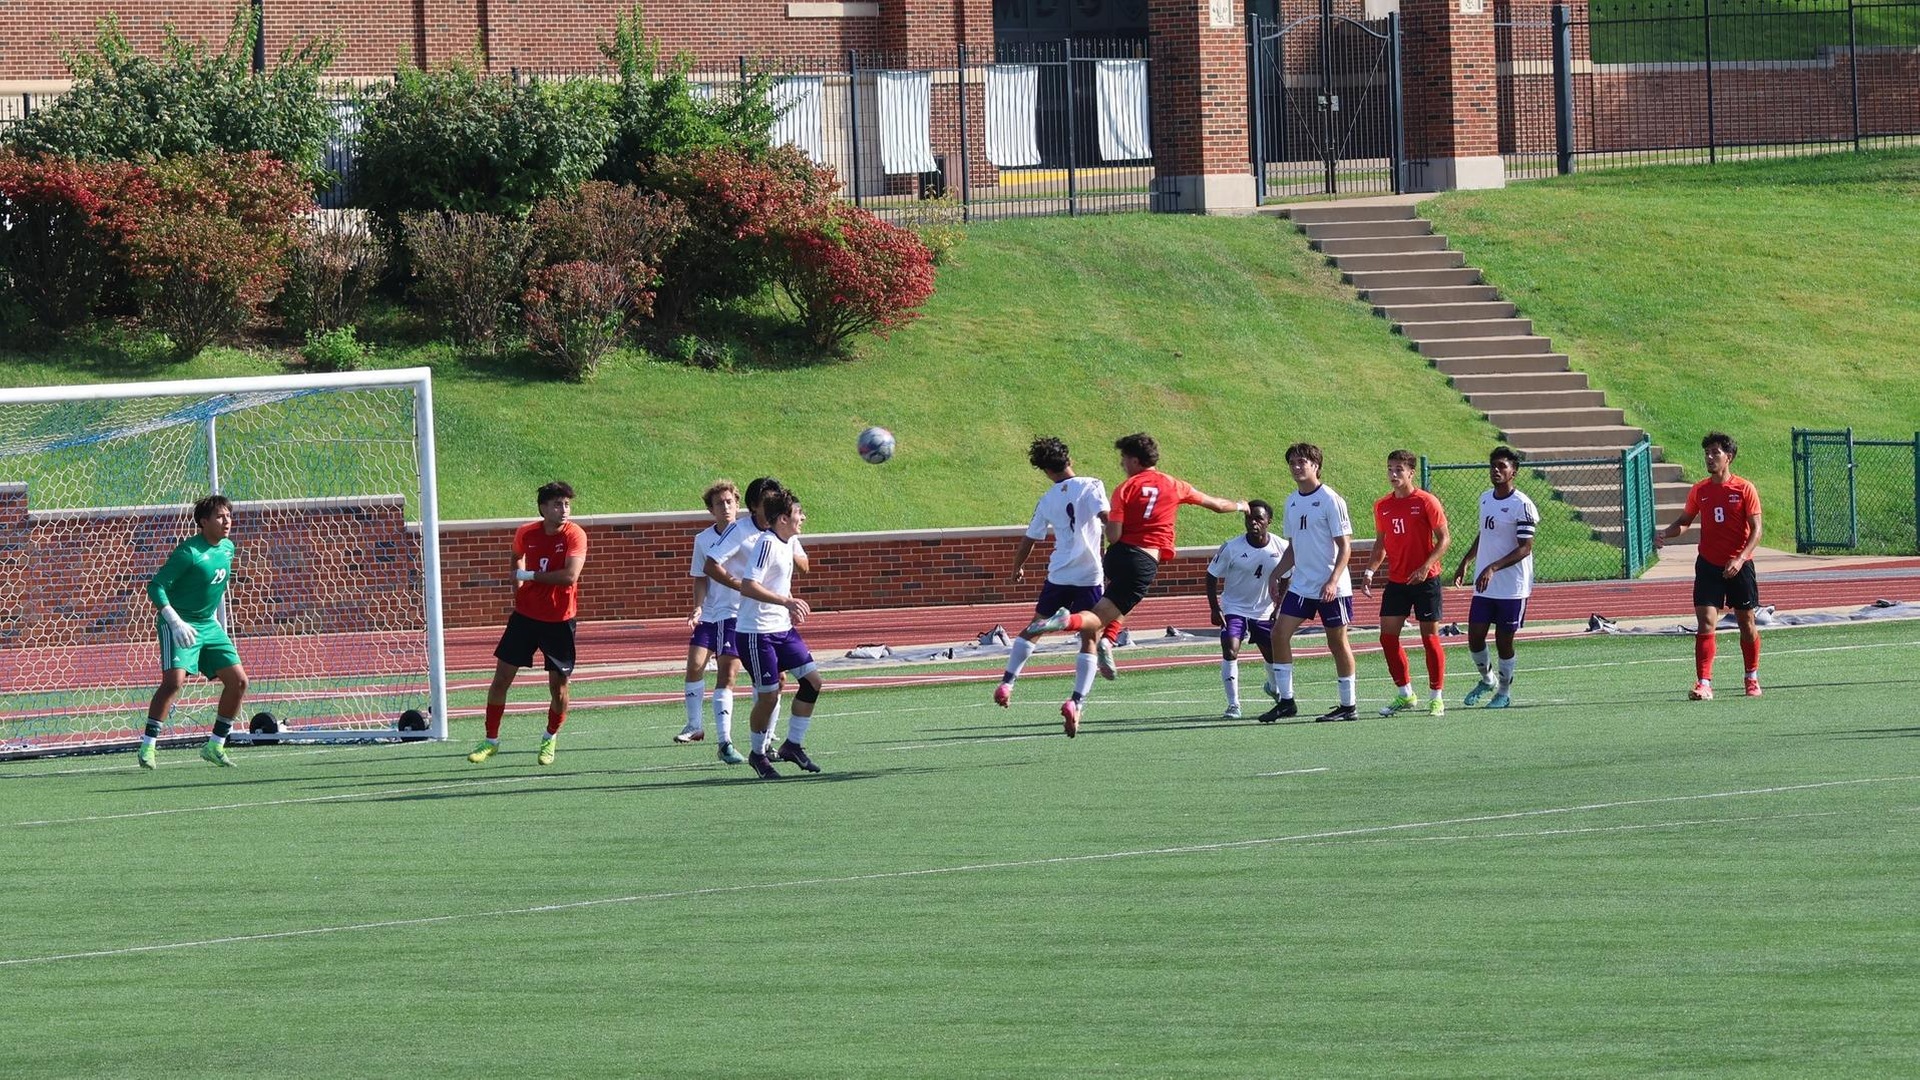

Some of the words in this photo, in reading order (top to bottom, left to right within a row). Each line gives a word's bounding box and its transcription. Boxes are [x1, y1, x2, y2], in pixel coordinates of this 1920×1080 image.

[1141, 485, 1159, 519] 7
[1300, 514, 1308, 530] 11
[1485, 515, 1495, 530] 16
[1714, 506, 1725, 523] 8
[1392, 518, 1405, 534] 31
[211, 568, 227, 584] 29
[1254, 564, 1263, 579] 4
